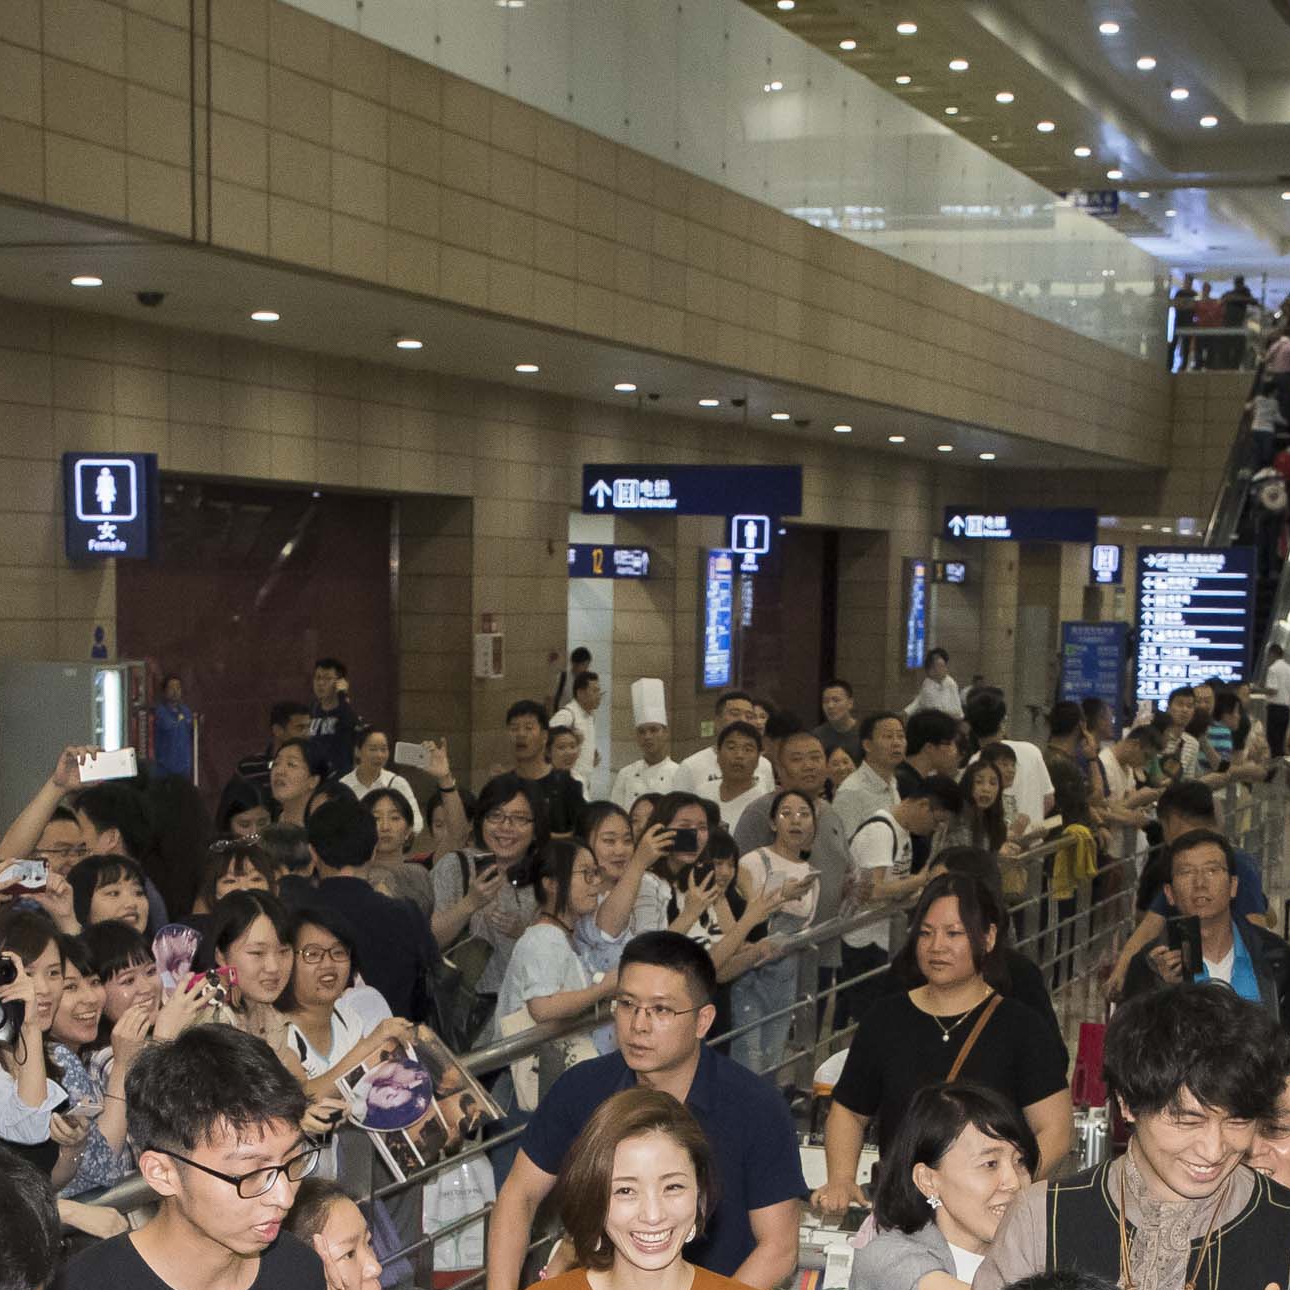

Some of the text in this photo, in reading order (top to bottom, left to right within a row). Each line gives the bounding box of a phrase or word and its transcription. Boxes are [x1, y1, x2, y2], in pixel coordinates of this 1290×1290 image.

[639, 479, 671, 498] 电梯
[96, 521, 118, 540] 女
[87, 538, 127, 551] Female
[591, 548, 604, 575] 12
